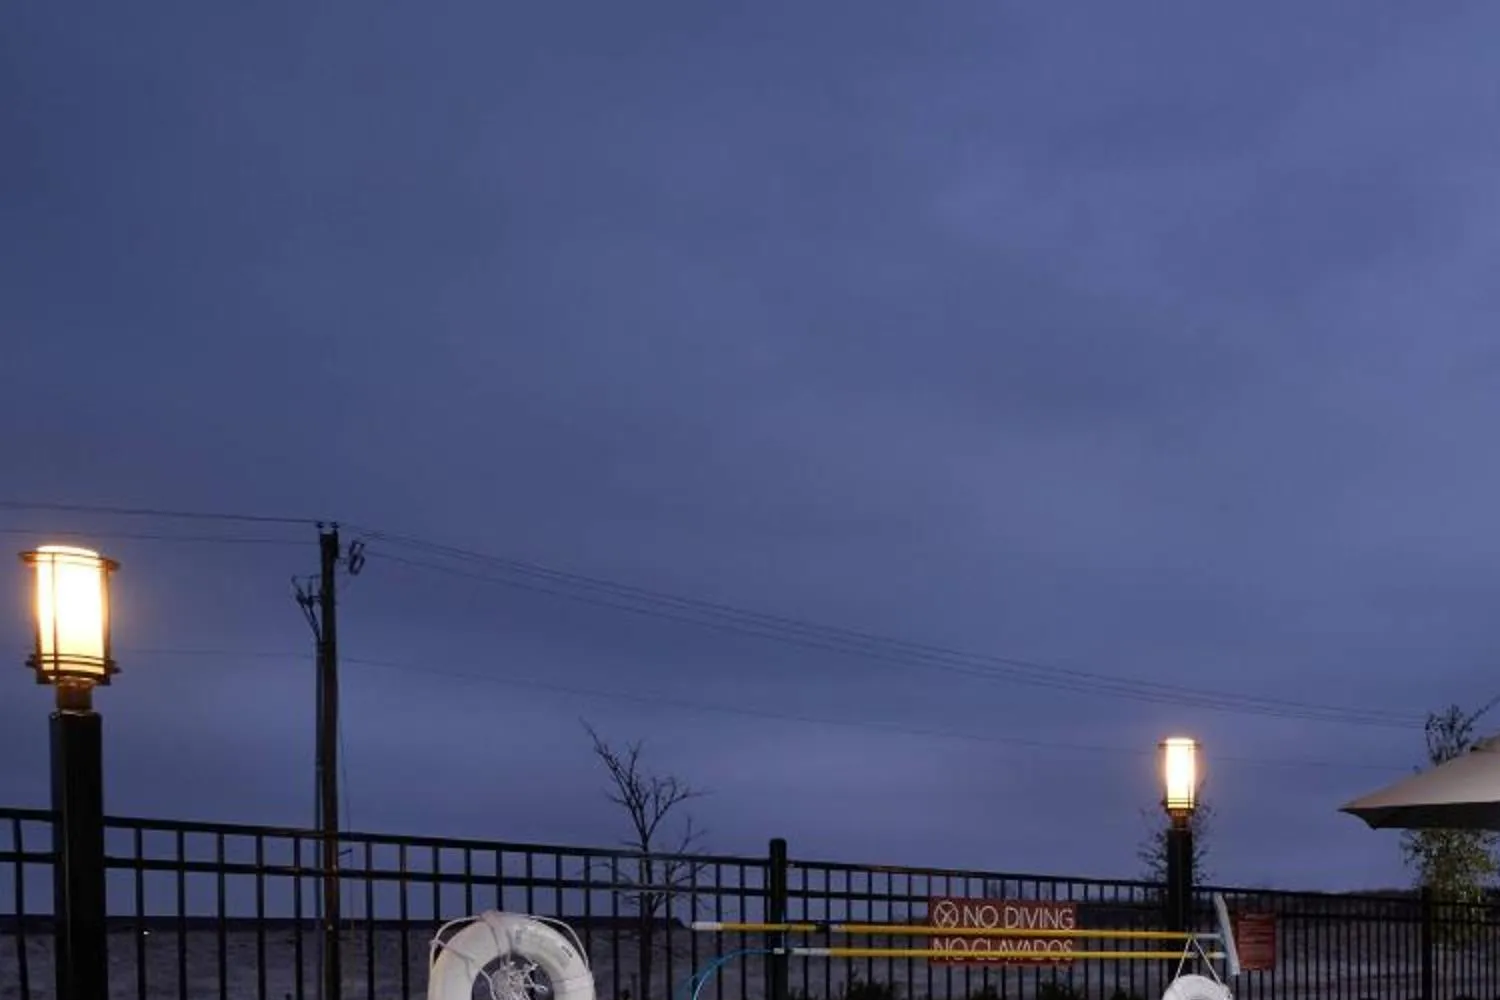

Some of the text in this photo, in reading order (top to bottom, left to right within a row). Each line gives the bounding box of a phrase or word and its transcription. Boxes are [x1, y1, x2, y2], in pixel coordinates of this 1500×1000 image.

[963, 904, 1075, 930] NO DIVING
[933, 937, 968, 961] NO
